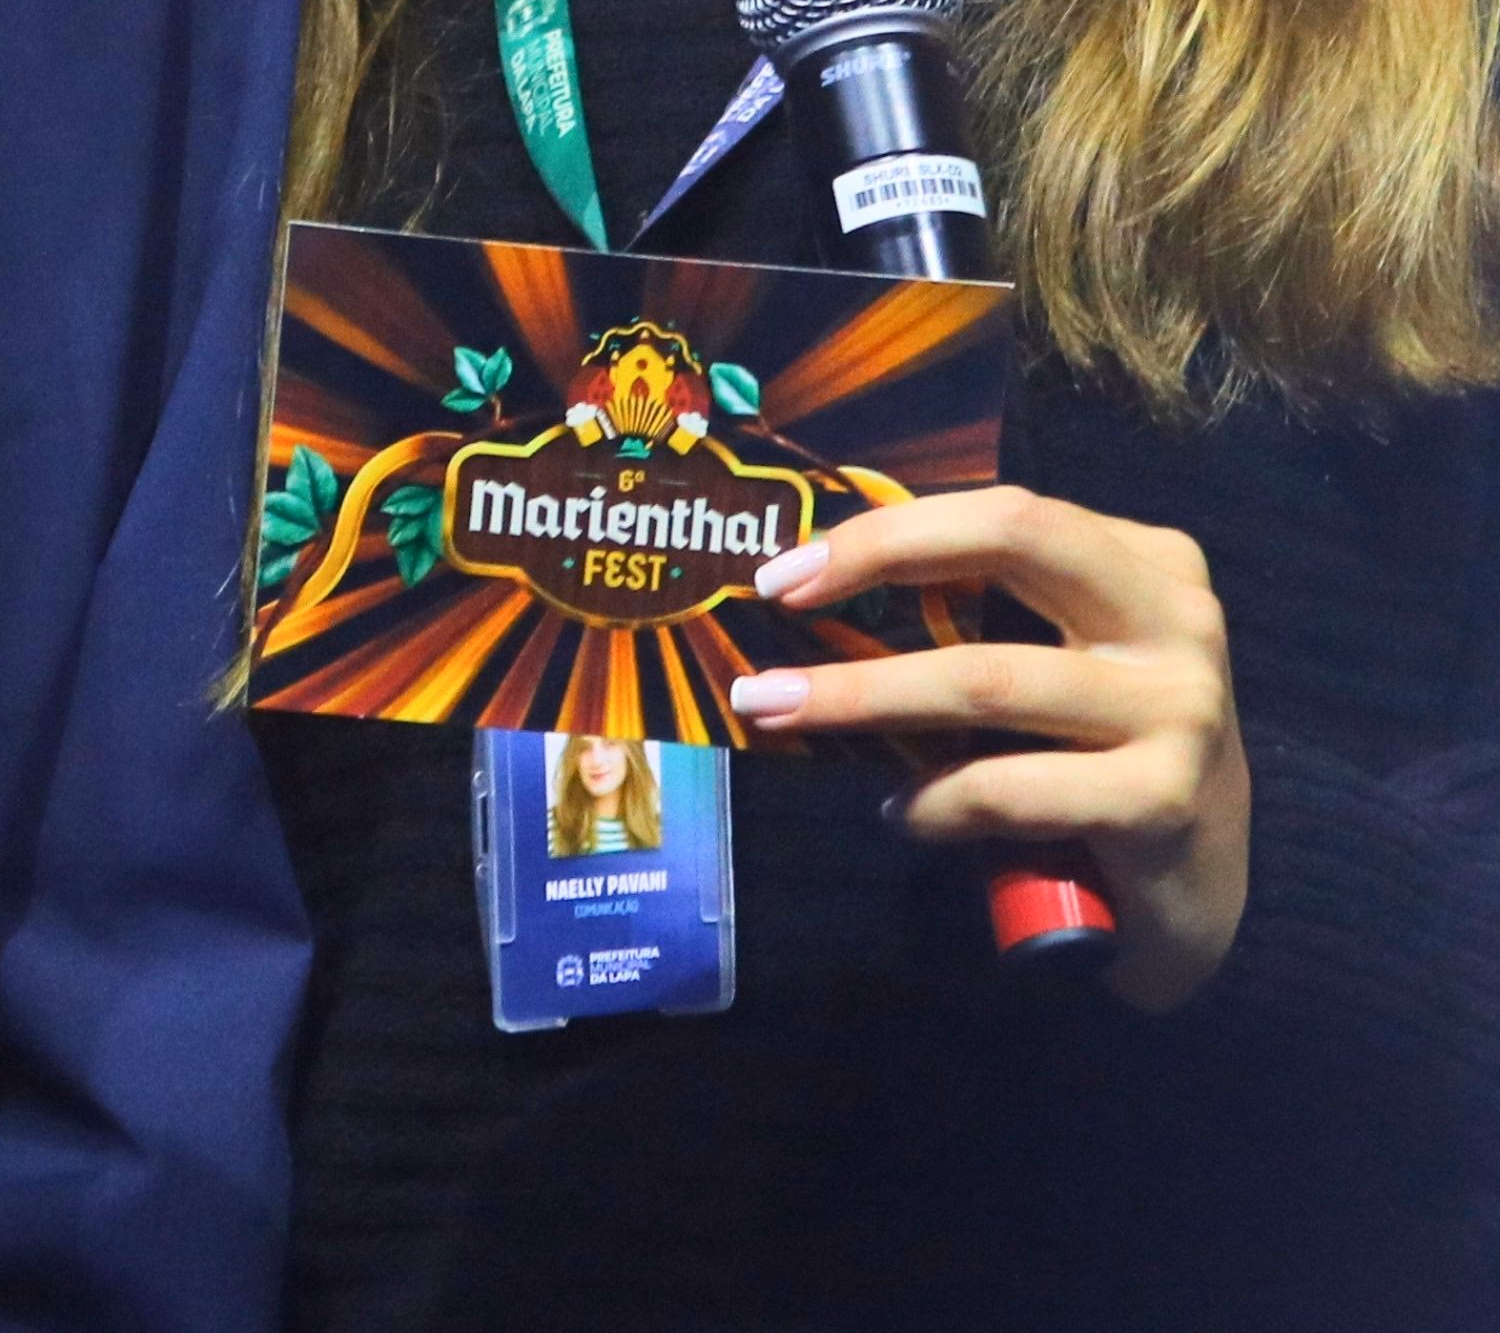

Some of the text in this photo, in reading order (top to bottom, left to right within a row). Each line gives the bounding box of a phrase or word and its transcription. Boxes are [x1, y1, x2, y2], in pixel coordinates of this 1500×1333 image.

[510, 47, 537, 135] DA LAPA
[543, 27, 577, 139] PREFEITURA
[468, 478, 783, 558] Marienthal
[582, 548, 668, 592] FEST
[545, 870, 668, 902] NAELLY PAVANI
[589, 945, 661, 964] PREFEITURA
[589, 969, 641, 986] DA LAPA
